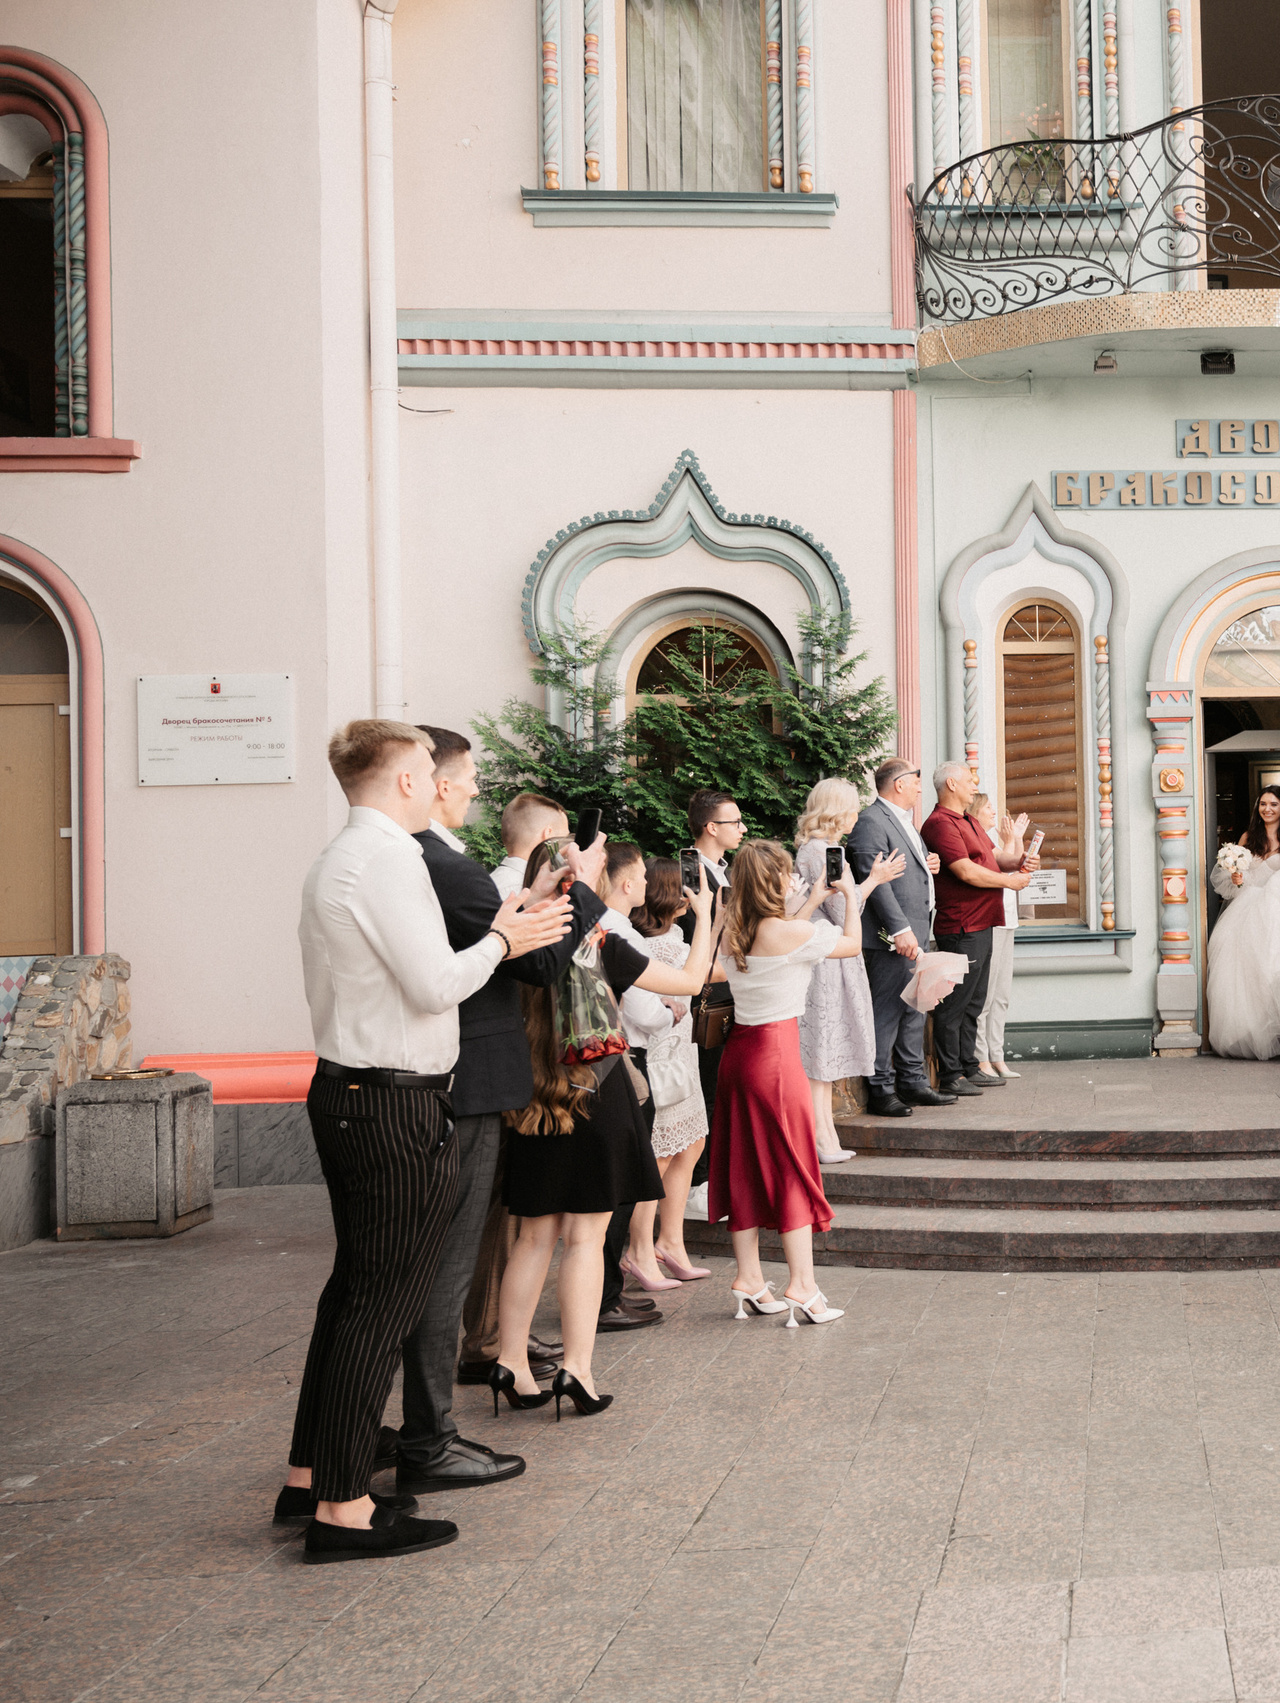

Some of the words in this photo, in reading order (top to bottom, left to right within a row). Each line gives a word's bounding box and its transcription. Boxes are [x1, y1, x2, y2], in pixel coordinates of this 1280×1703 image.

[162, 718, 191, 726] Дворец
[192, 717, 254, 725] бракосочетания
[217, 734, 243, 742] РАБОТЫ
